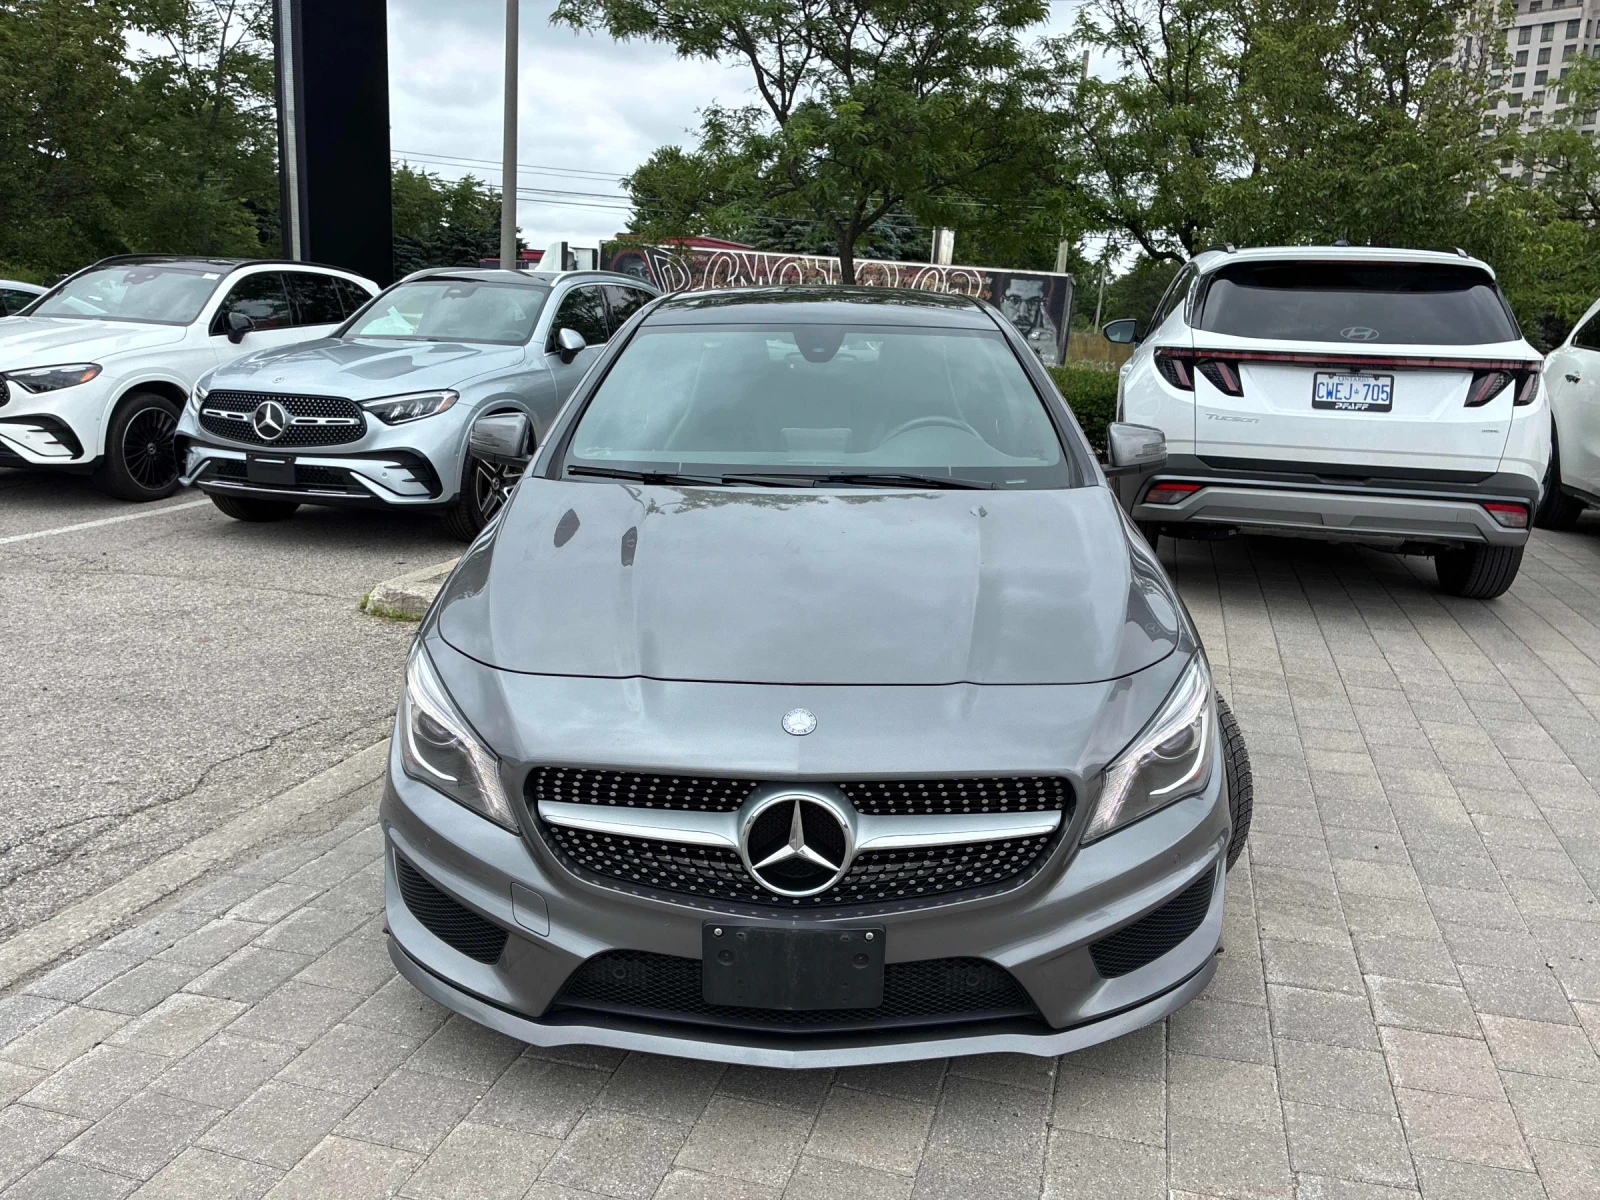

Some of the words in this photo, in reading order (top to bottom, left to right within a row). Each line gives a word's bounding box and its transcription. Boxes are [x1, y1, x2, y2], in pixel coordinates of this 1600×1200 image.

[1316, 382, 1353, 401] CWEJ
[1362, 383, 1390, 402] 705
[1335, 402, 1370, 410] PFAFF
